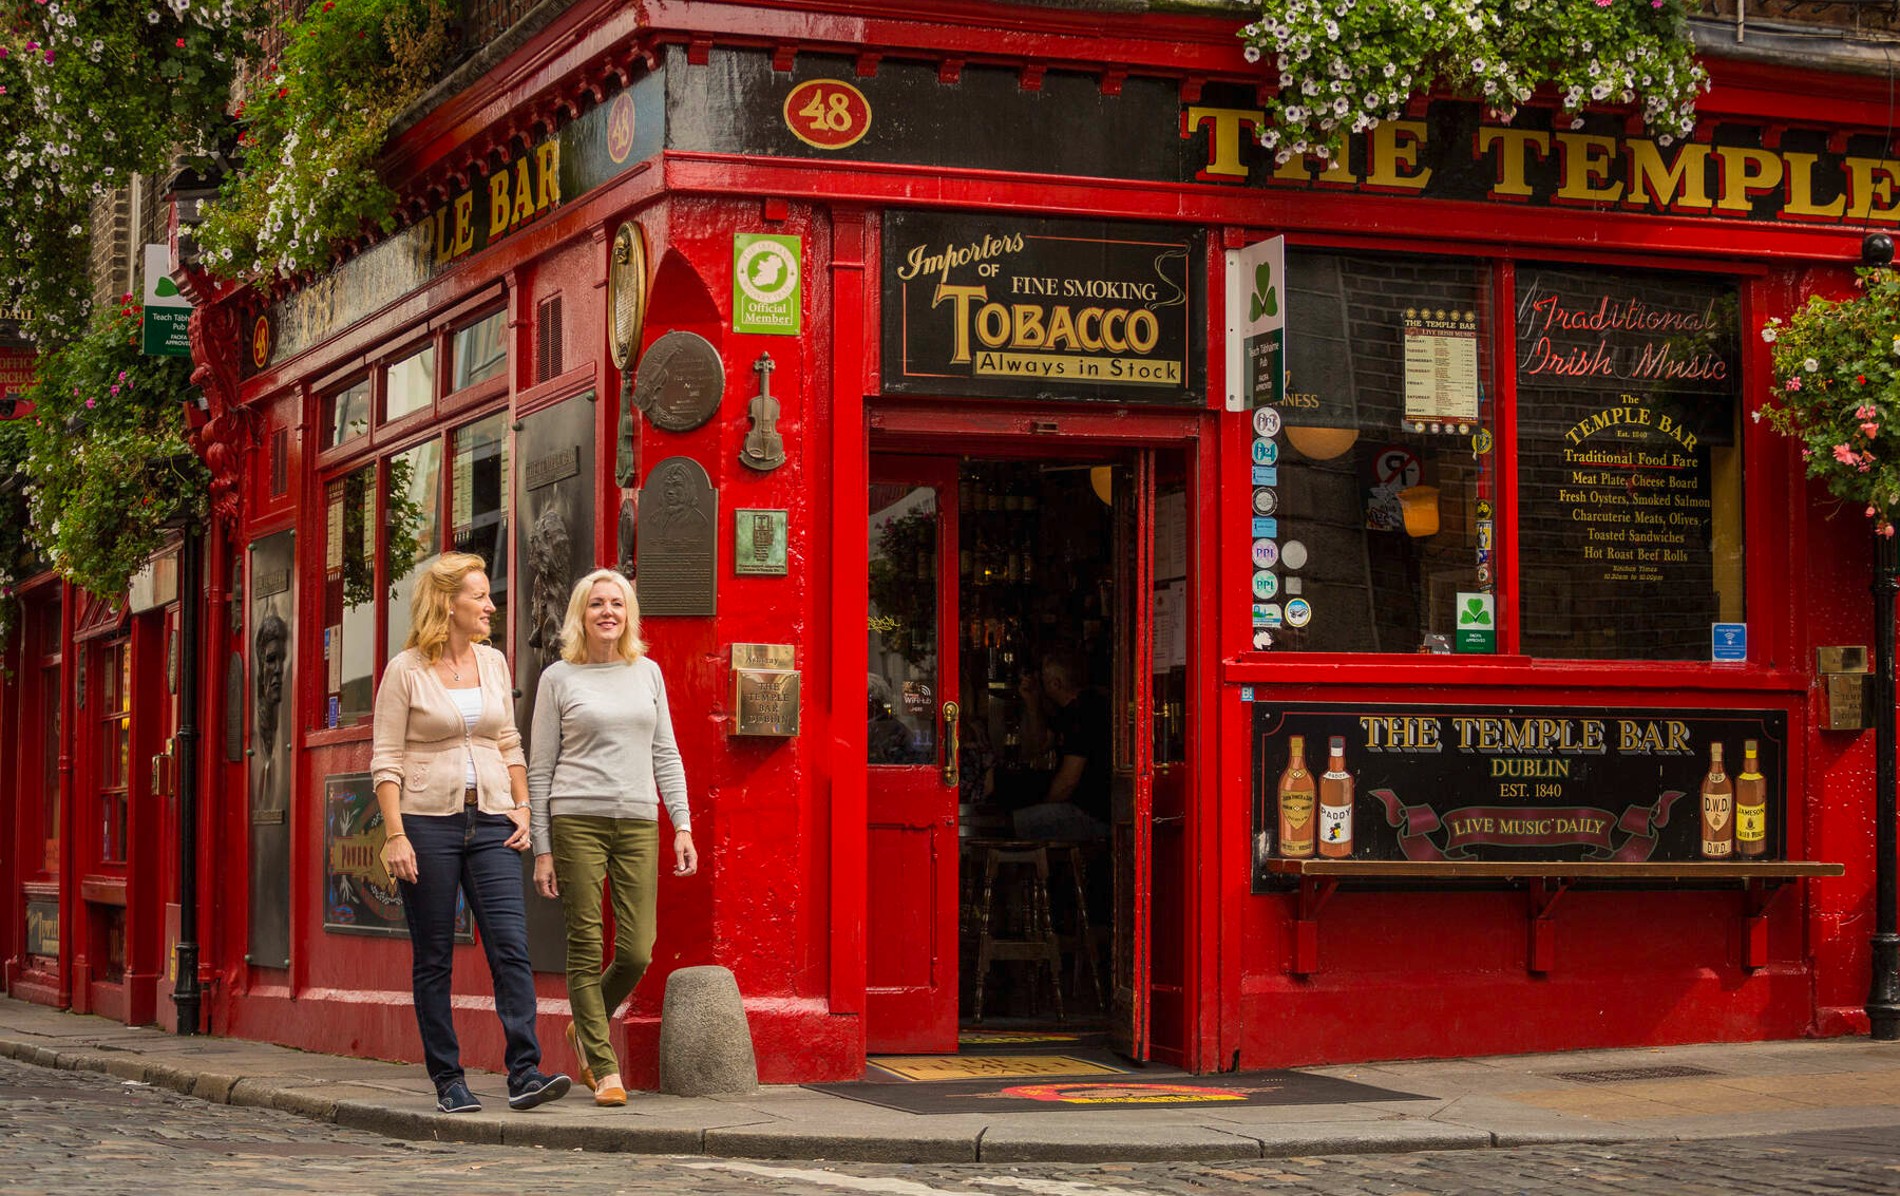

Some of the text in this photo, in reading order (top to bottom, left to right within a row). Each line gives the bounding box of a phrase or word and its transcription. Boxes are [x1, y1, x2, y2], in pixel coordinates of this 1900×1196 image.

[799, 88, 852, 131] 48
[615, 106, 629, 150] 48
[1476, 126, 1900, 224] TEMPLE
[488, 136, 561, 238] BAR
[897, 232, 1025, 283] Importers
[978, 264, 1000, 278] OF
[1011, 276, 1158, 301] FINE SMOKING
[152, 313, 172, 321] Teach
[748, 303, 786, 314] Official
[1533, 295, 1718, 331] Traditional
[173, 323, 186, 331] Pub
[745, 313, 790, 324] Member
[932, 284, 1160, 364] TOBACCO
[1405, 319, 1422, 327] THE
[1426, 320, 1456, 328] TEMPLE
[980, 353, 1177, 380] Always in Stock
[1529, 336, 1726, 380] Irish Music
[1621, 394, 1639, 404] The
[1565, 407, 1698, 453] TEMPLE BAR
[1617, 430, 1630, 438] Est.
[1564, 449, 1698, 468] Traditional Food Fare
[1573, 472, 1698, 489] Meat Plate, Cheese Board
[1560, 490, 1710, 508] Fresh Oysters, Smoked Salmon
[1572, 509, 1631, 523] Charcuterie
[1635, 511, 1666, 525] Meats,
[1588, 528, 1685, 544] Toasted Sandwiches
[1256, 548, 1274, 558] PPI
[1585, 547, 1688, 562] Hot Roast Beef Rolls
[1256, 580, 1274, 590] PPI
[1360, 716, 1693, 753] THE TEMPLE BAR
[1491, 758, 1569, 776] DUBLIN
[1500, 783, 1562, 798] EST. 1840
[1321, 806, 1351, 820] PADDY
[1705, 797, 1729, 813] D.W.D.
[1454, 817, 1606, 836] LIVE MUSIC DAILY
[341, 845, 373, 868] POWERS
